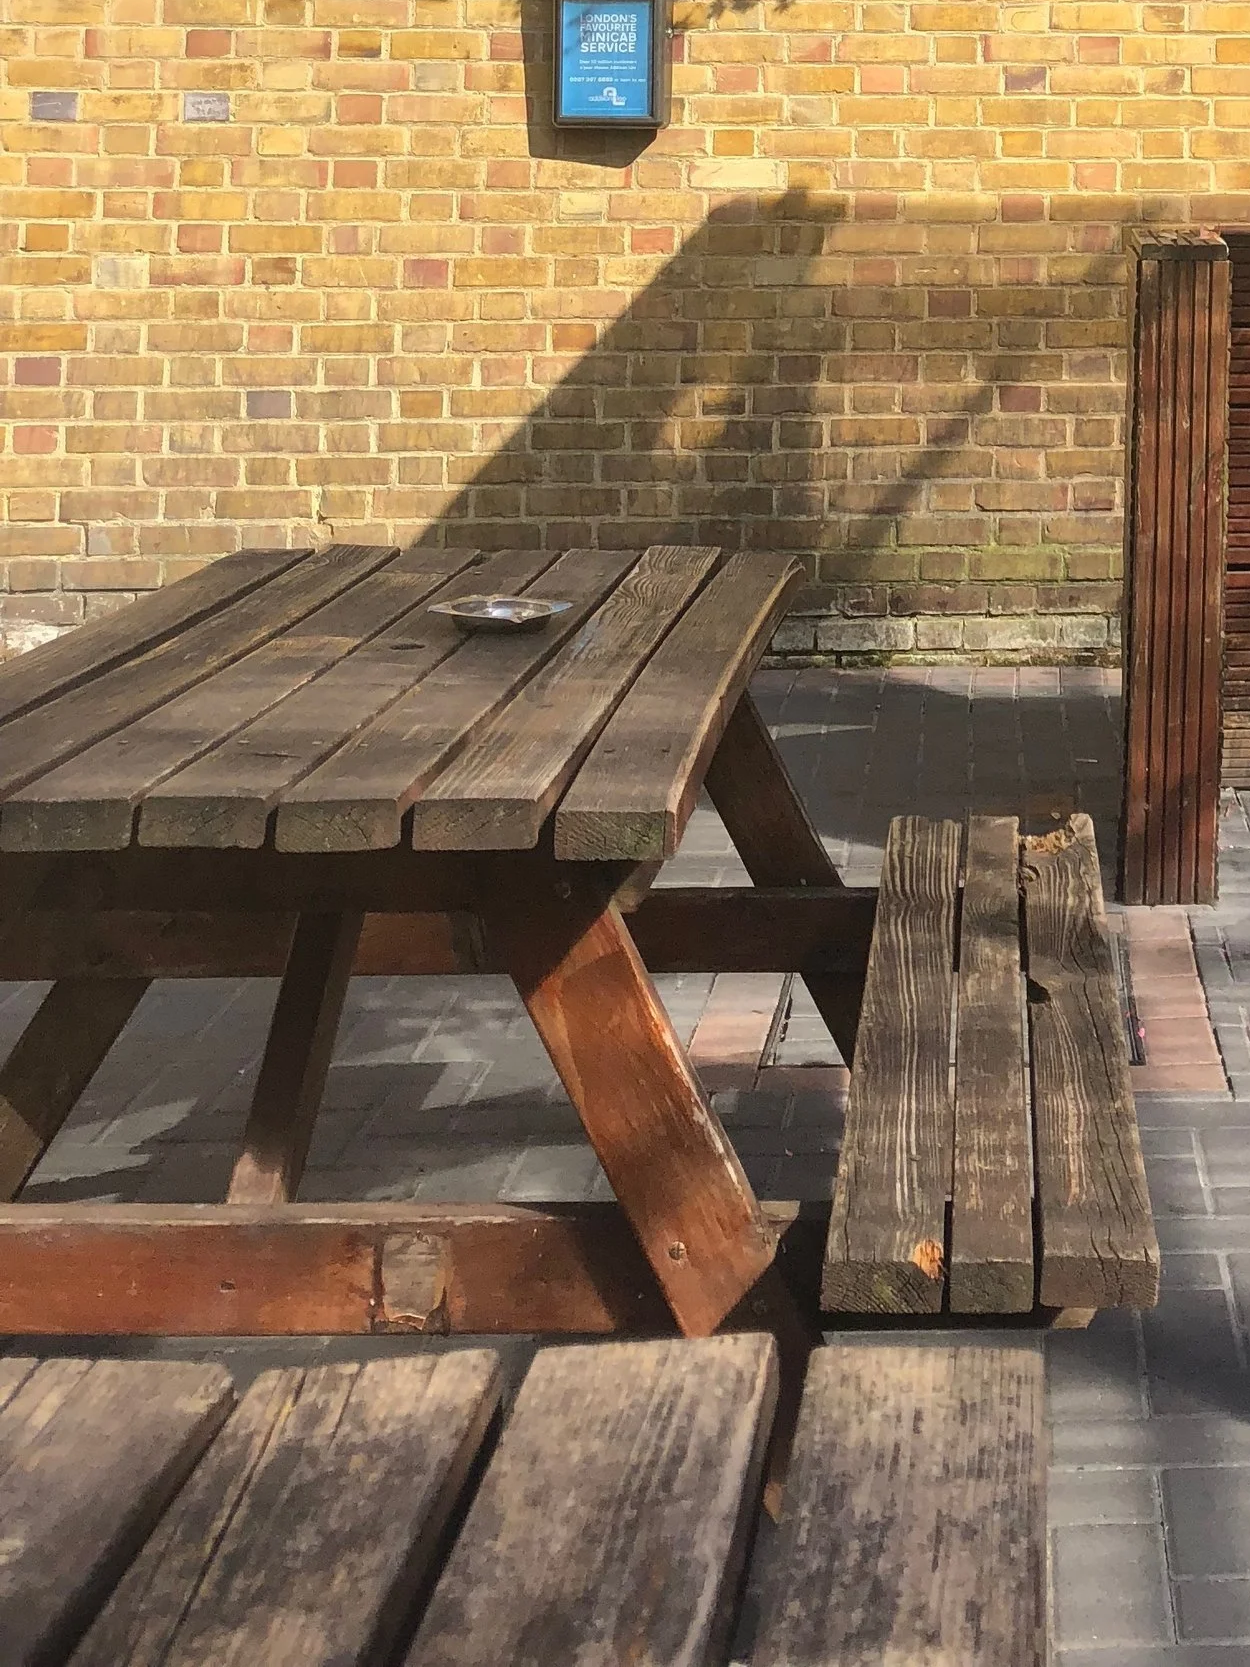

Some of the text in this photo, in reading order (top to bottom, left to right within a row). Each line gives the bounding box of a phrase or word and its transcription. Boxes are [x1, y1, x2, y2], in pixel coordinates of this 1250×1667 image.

[580, 14, 637, 23] LONDON'S
[580, 23, 637, 32] FAVOURITE
[580, 32, 637, 43] MINICAB
[580, 42, 636, 53] SERVICE
